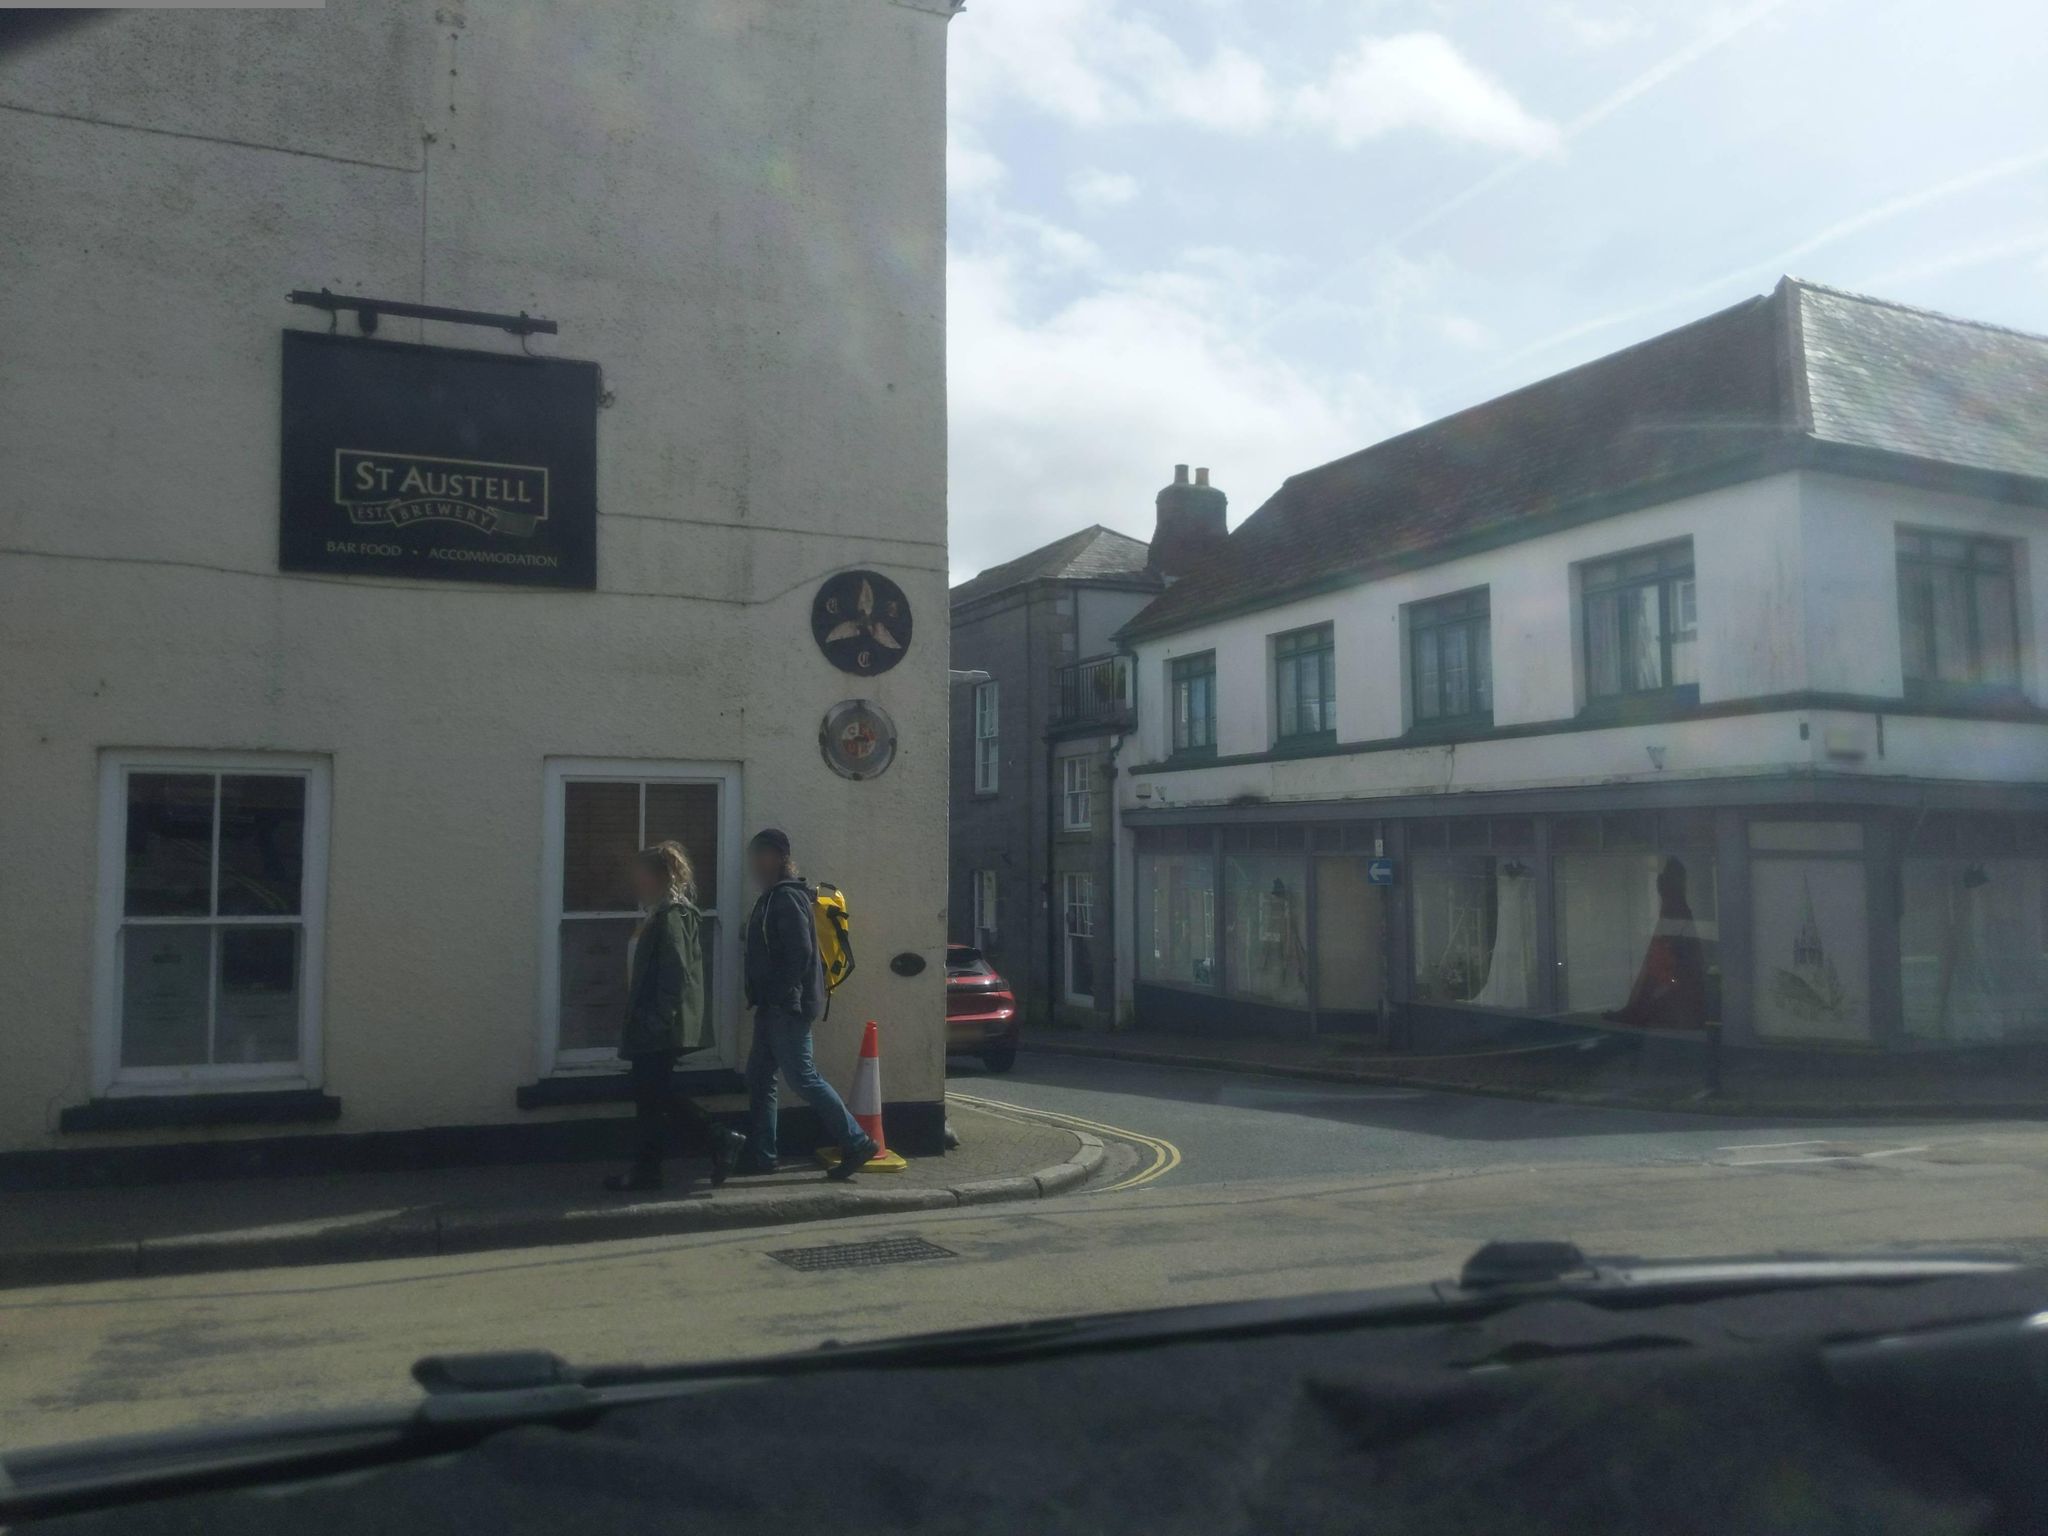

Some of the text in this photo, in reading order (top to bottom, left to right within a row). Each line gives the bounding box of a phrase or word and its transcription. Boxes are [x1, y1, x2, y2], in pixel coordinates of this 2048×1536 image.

[399, 465, 531, 503] AUSTELL
[400, 503, 490, 526] BREWERY
[326, 541, 558, 568] BAR FOOD ACCOMMODATION
